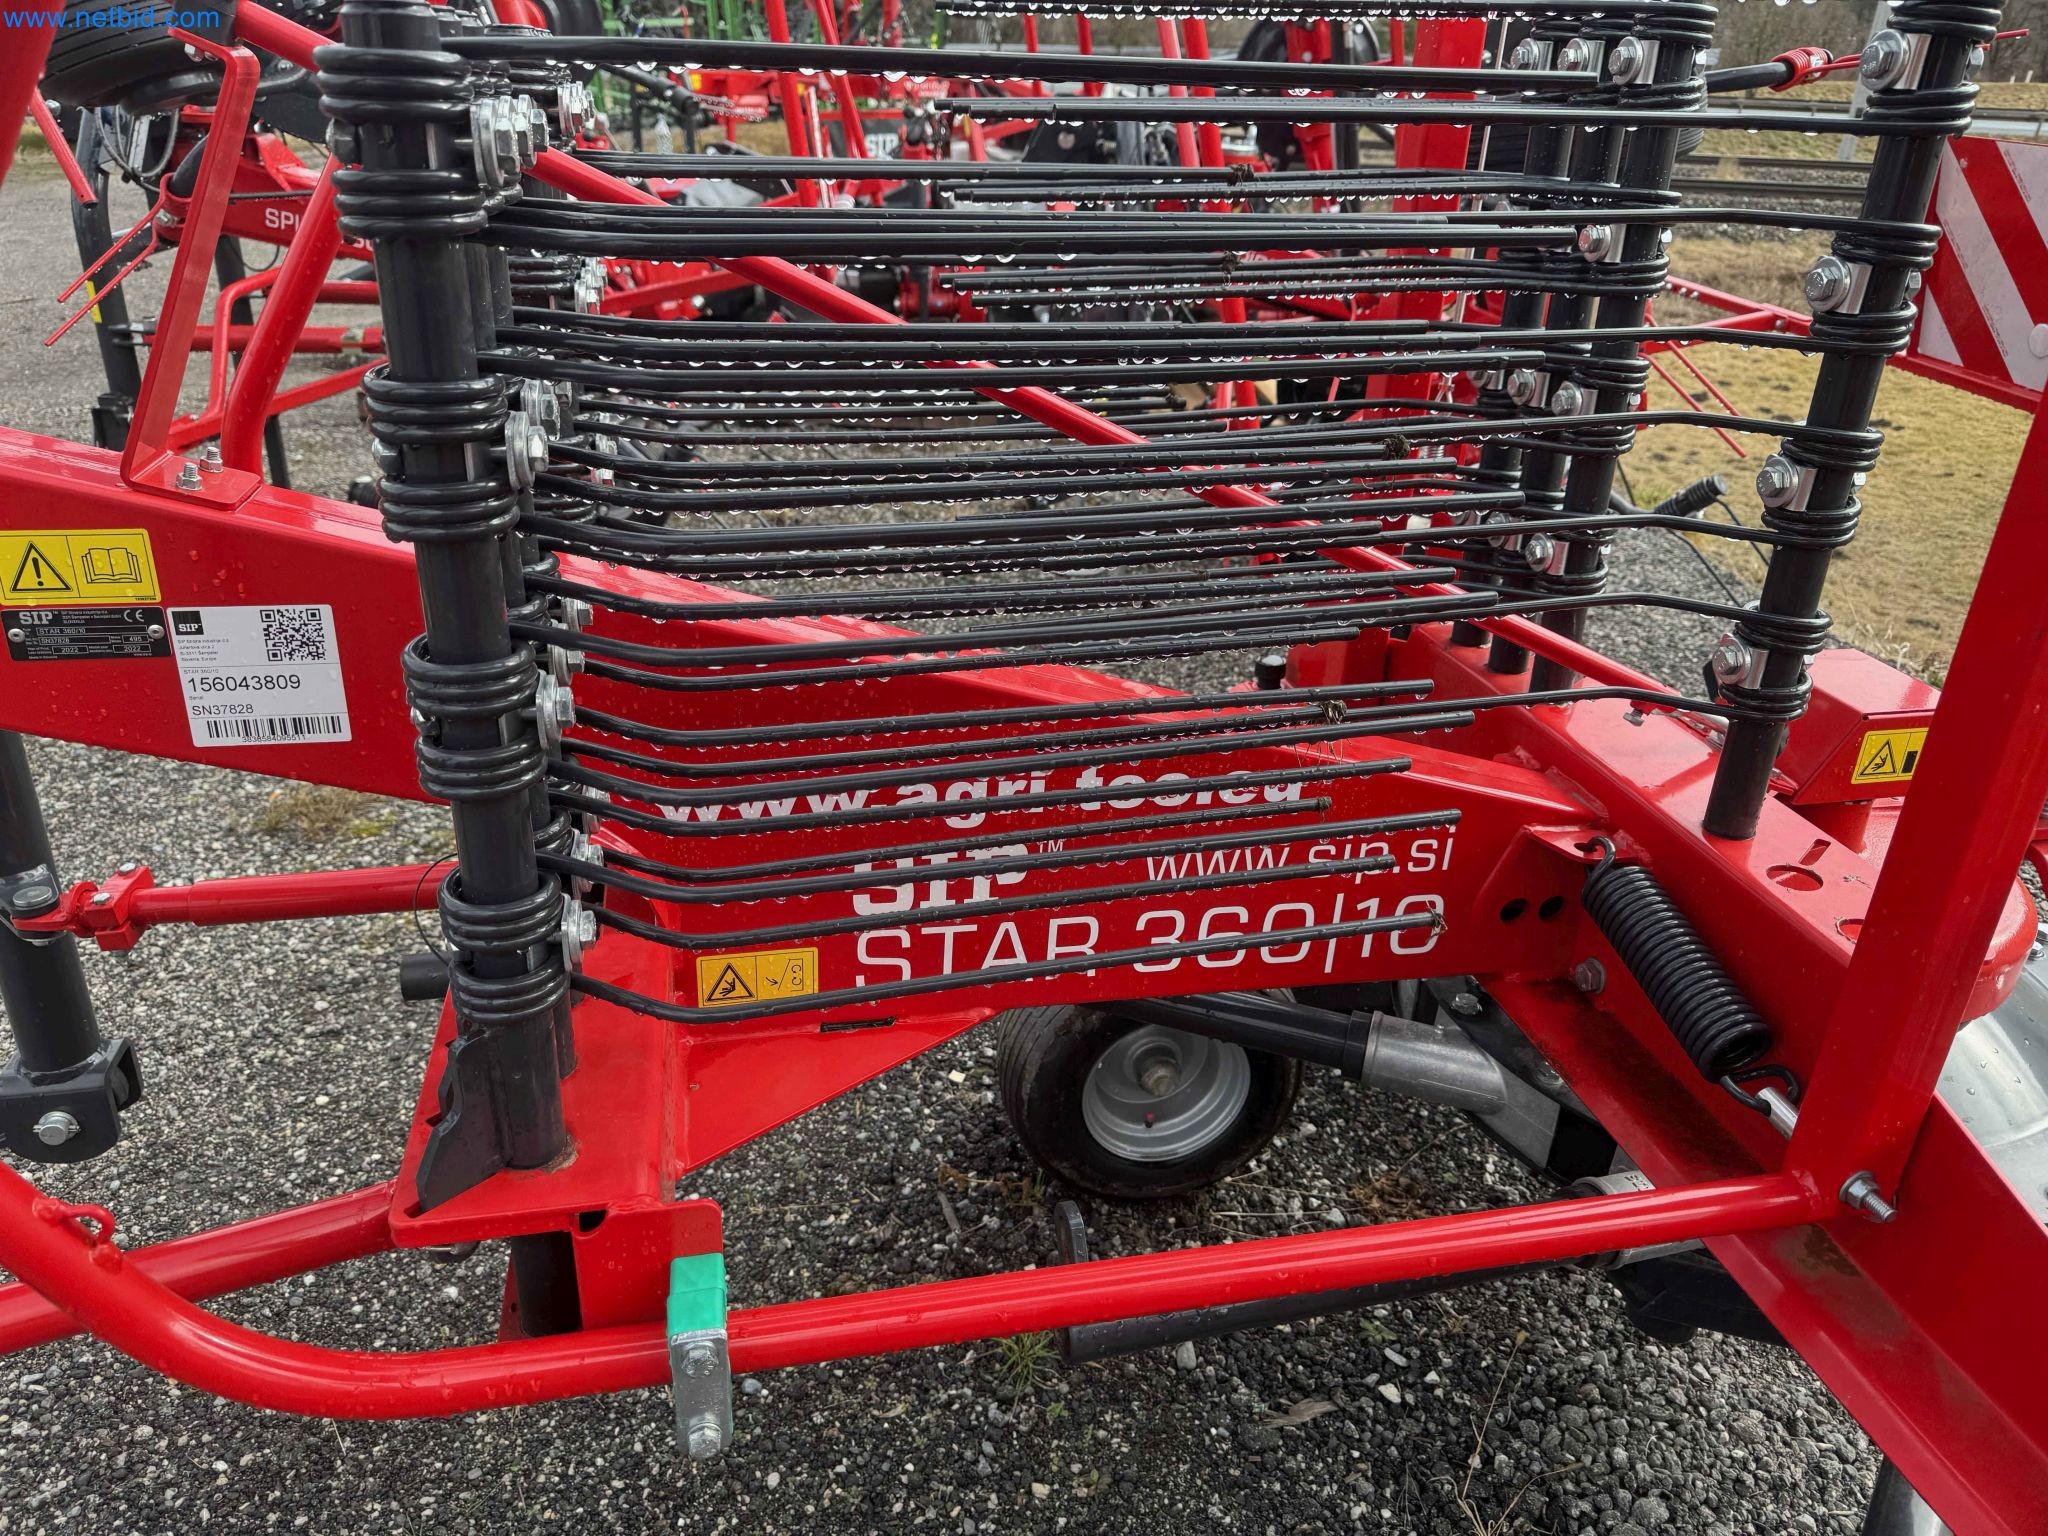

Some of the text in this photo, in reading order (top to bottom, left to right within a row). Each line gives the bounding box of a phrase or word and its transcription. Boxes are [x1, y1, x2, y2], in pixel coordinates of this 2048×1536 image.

[187, 674, 301, 692] 156043809
[192, 703, 254, 716] SN37828
[1146, 823, 1458, 884] wwwsip.si
[855, 915, 1101, 988] STAR
